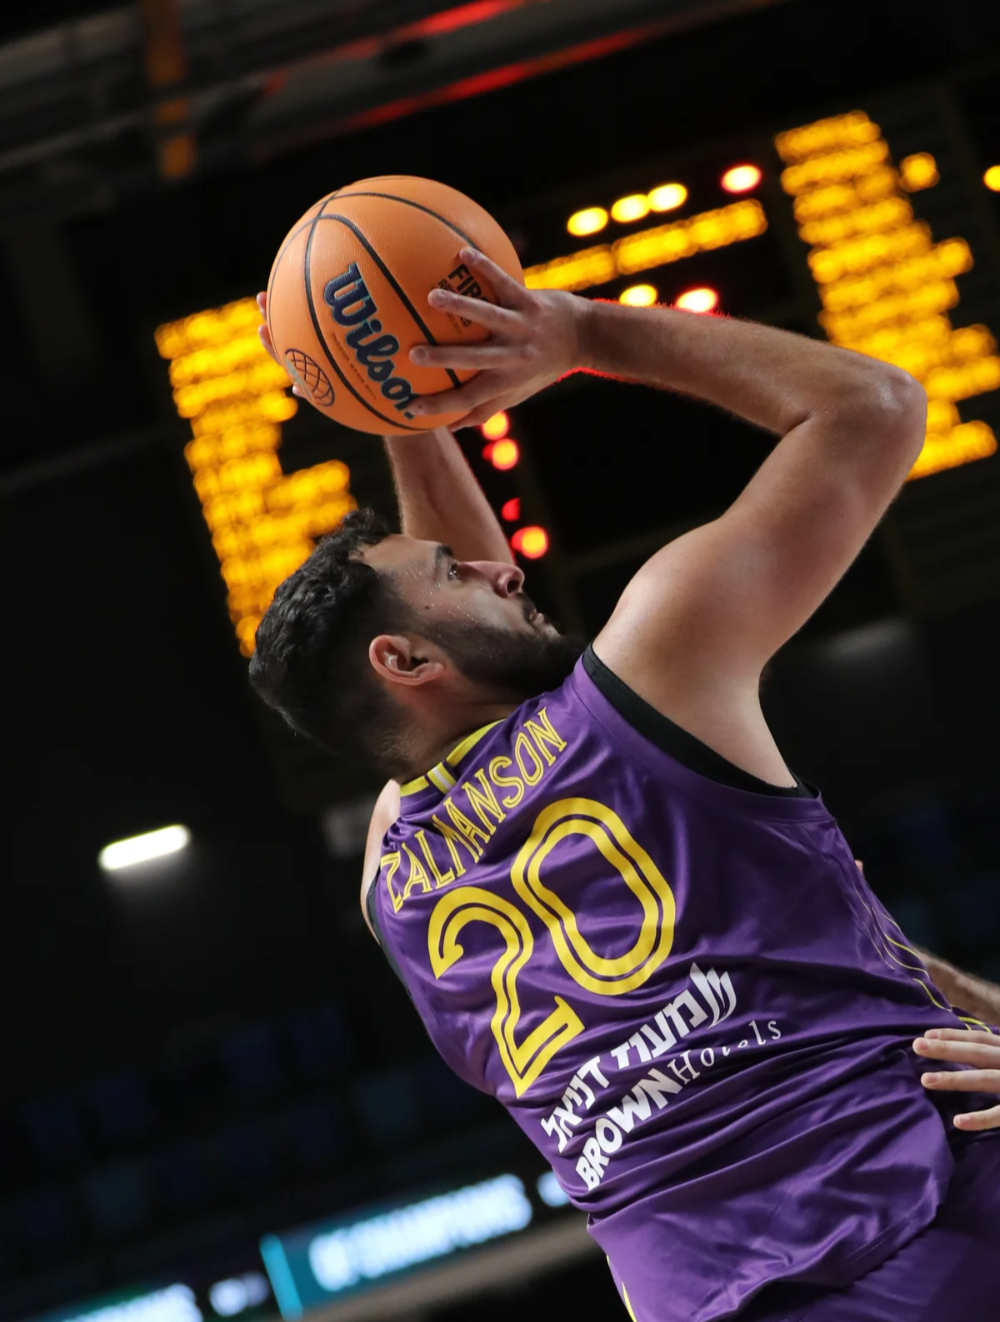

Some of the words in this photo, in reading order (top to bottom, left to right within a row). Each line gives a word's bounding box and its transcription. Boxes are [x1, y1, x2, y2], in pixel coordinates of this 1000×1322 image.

[380, 706, 567, 914] ZALMANSON
[427, 797, 676, 1099] 20
[540, 1055, 610, 1154] דניאל
[575, 1068, 684, 1192] BROWN
